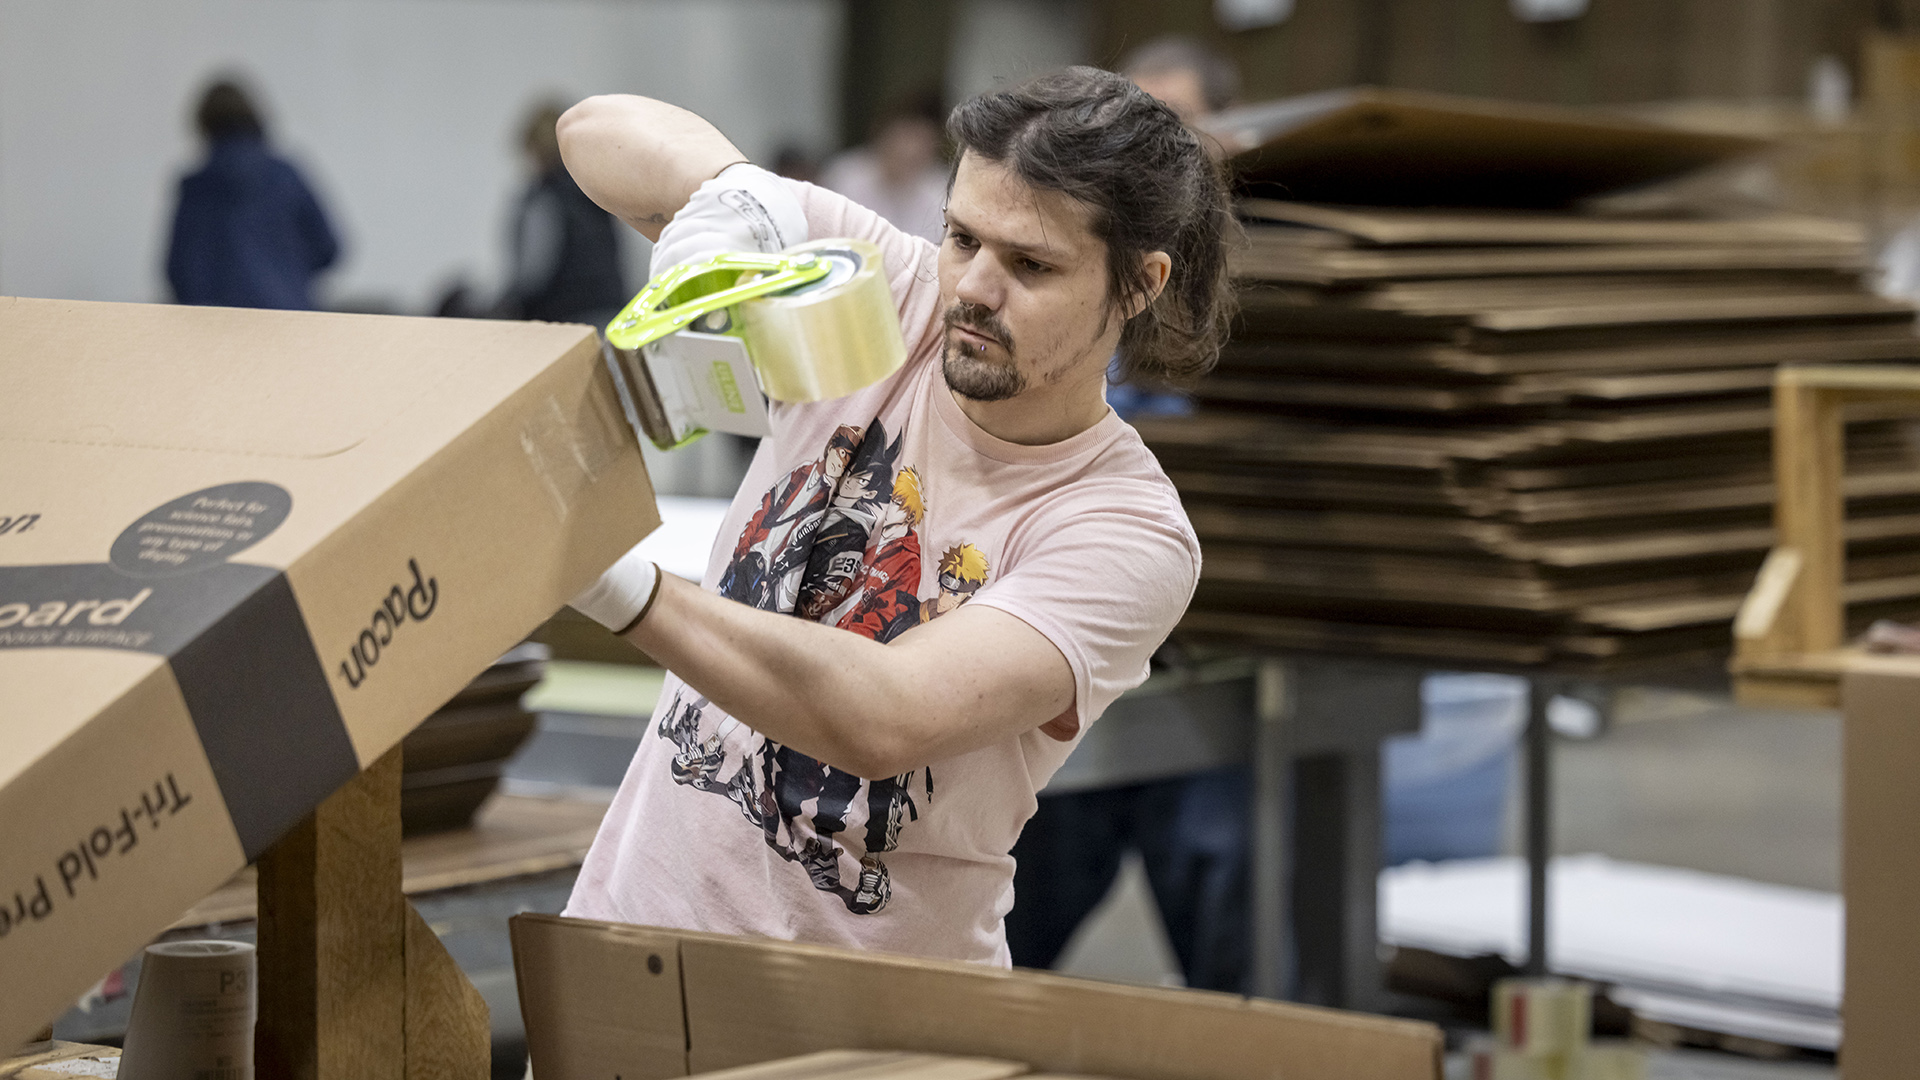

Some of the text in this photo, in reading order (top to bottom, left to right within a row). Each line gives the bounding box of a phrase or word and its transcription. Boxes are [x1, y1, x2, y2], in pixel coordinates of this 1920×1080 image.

[245, 500, 268, 514] for
[0, 587, 152, 628] oard
[338, 557, 438, 689] Pacon
[57, 773, 192, 898] Tri-Fold
